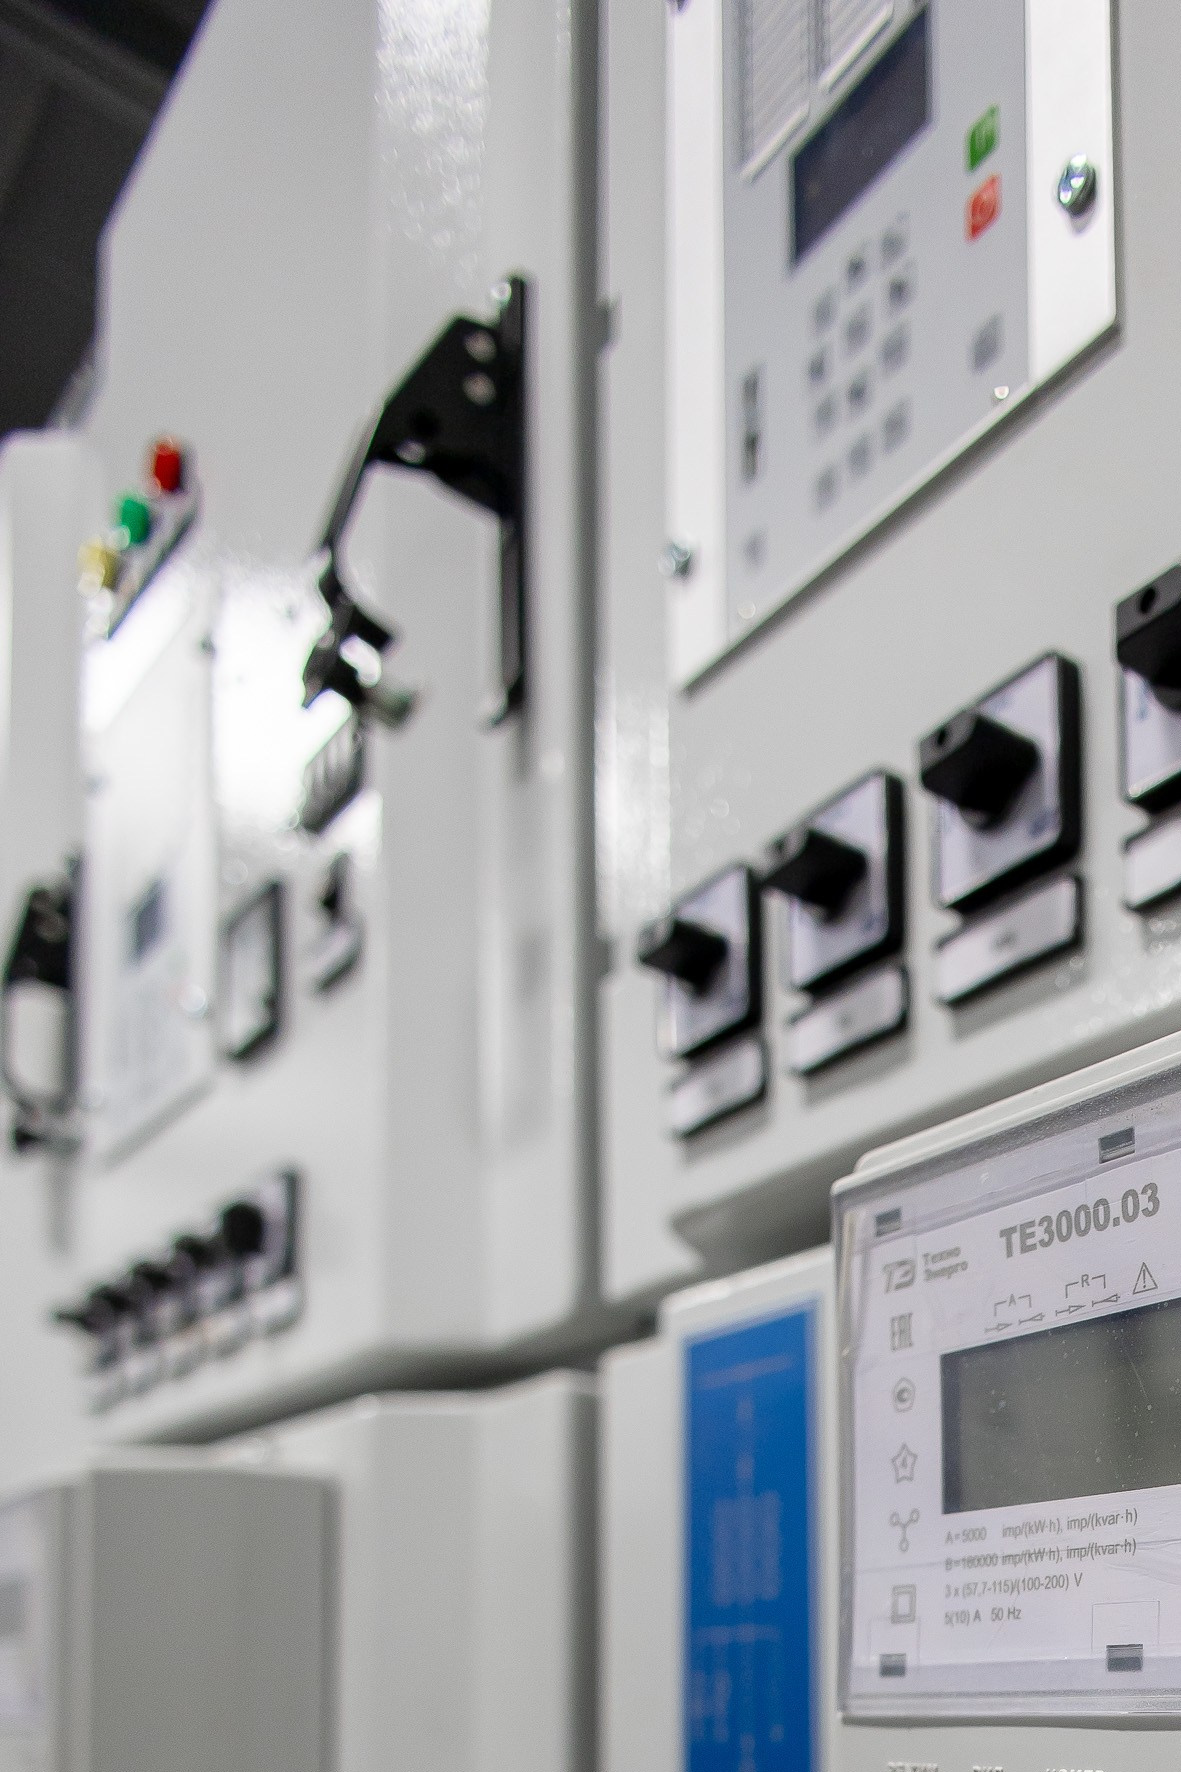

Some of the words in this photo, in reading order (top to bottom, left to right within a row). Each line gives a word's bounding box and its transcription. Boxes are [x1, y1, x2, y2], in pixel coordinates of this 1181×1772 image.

[1081, 1273, 1090, 1288] R
[1073, 1572, 1083, 1587] V
[991, 1607, 1004, 1622] 50
[1007, 1606, 1022, 1621] Hz
